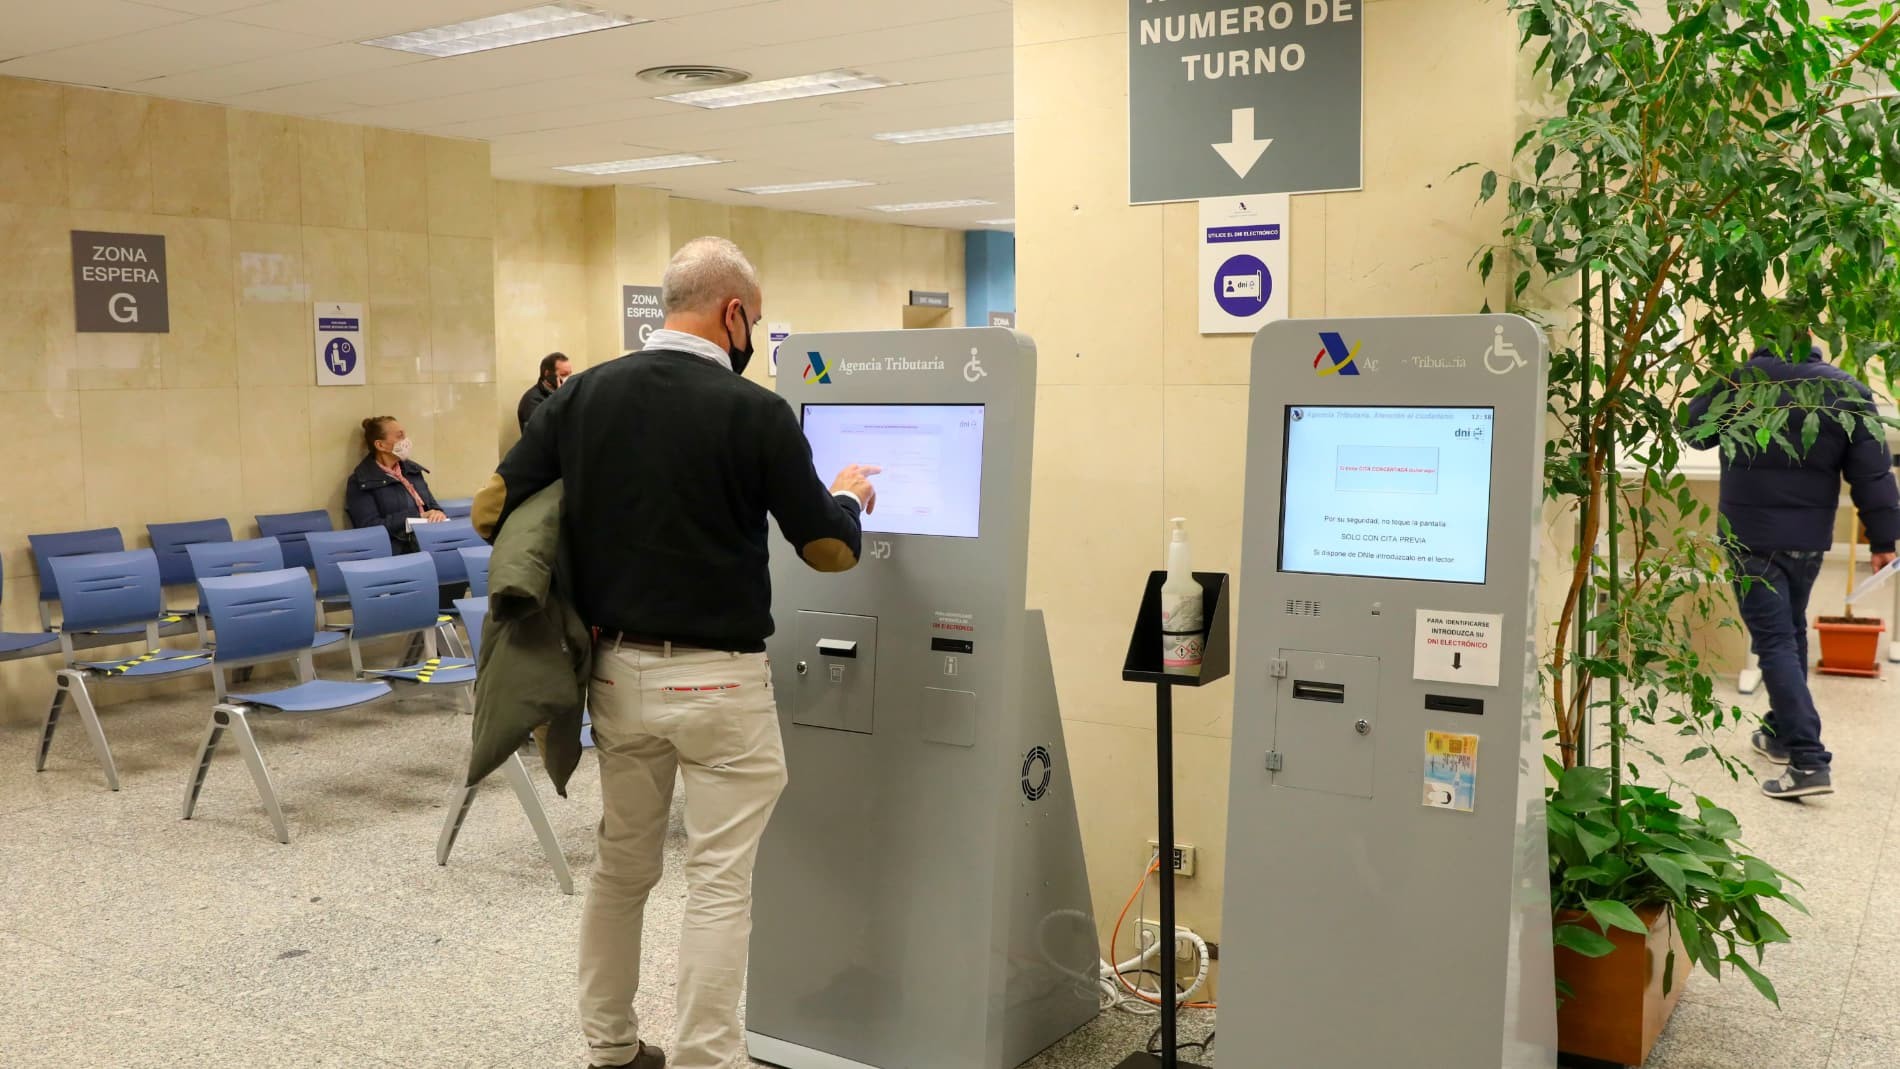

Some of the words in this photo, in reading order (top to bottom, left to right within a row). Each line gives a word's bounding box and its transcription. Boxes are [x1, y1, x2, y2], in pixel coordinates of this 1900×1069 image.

[1140, 1, 1293, 45] NUMERO
[1305, 0, 1353, 25] DE
[1181, 43, 1306, 81] TURNO
[92, 246, 148, 262] ZONA
[82, 266, 160, 283] ESPERA
[1237, 280, 1248, 288] dni
[632, 294, 658, 304] ZONA
[108, 292, 138, 323] G
[627, 307, 664, 318] ESPERA
[838, 357, 882, 376] Agencia
[884, 356, 944, 370] Tributaria
[1455, 428, 1470, 437] dni
[1321, 550, 1346, 558] dispone
[1446, 619, 1489, 628] IDENTIFICARSE
[1432, 628, 1474, 636] INTRODUZCA
[1440, 639, 1488, 648] ELECTRÓNICO
